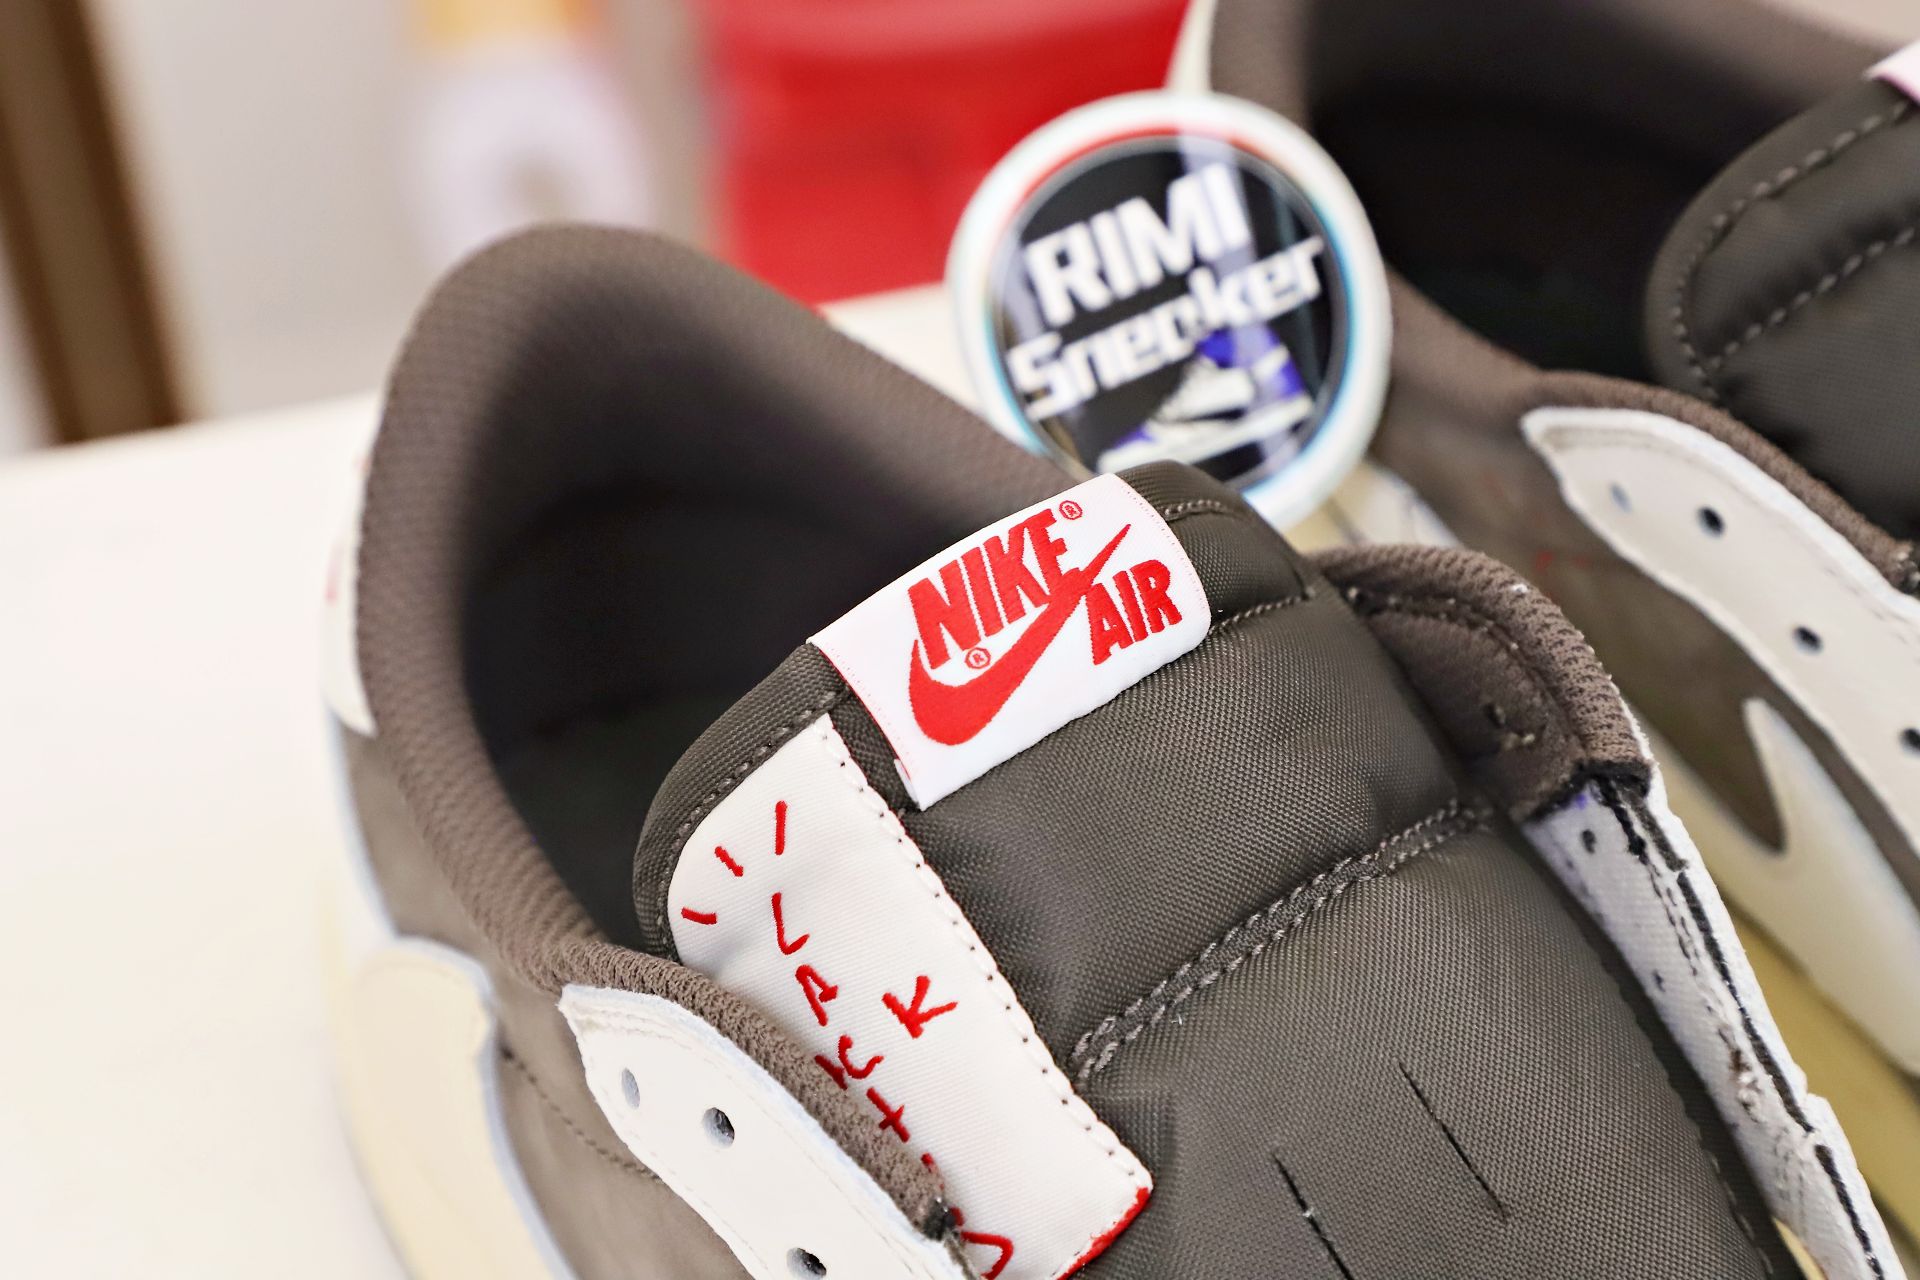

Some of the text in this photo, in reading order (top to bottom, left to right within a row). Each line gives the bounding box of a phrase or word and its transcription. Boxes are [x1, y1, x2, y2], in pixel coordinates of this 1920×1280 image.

[1024, 163, 1250, 326] RIMI
[908, 508, 1082, 670] NIKE
[1086, 559, 1183, 666] AIR
